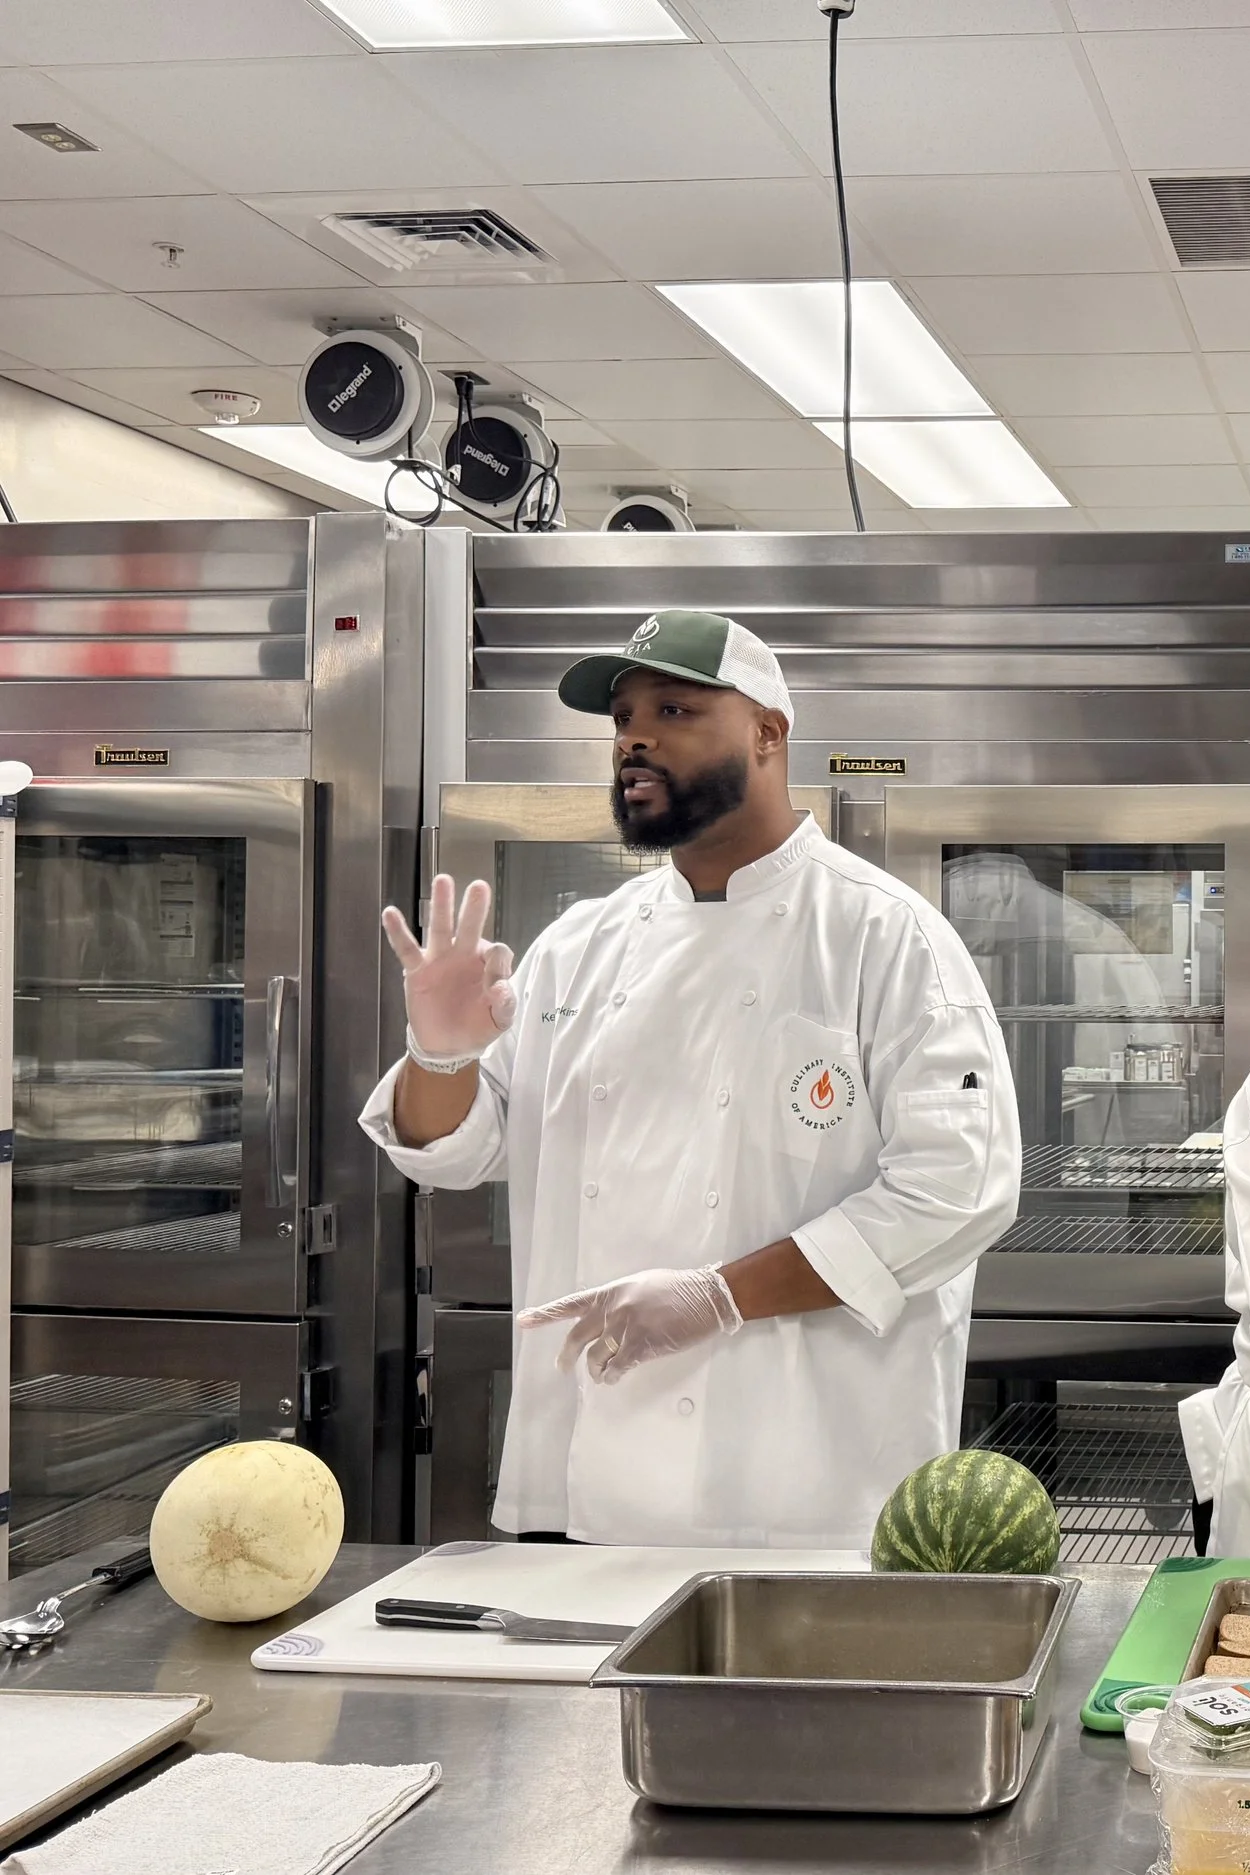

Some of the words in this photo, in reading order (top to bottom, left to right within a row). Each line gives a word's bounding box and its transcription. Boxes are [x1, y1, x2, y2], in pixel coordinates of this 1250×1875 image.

[214, 393, 238, 401] FIRE
[336, 363, 373, 405] legrand
[463, 445, 501, 475] legrand
[95, 744, 166, 764] Traulsen
[829, 752, 903, 772] Traulsen
[790, 1058, 824, 1093] CULINARY
[831, 1063, 855, 1107] INSTITUTE
[791, 1102, 801, 1113] OF
[798, 1115, 843, 1130] AMERICA
